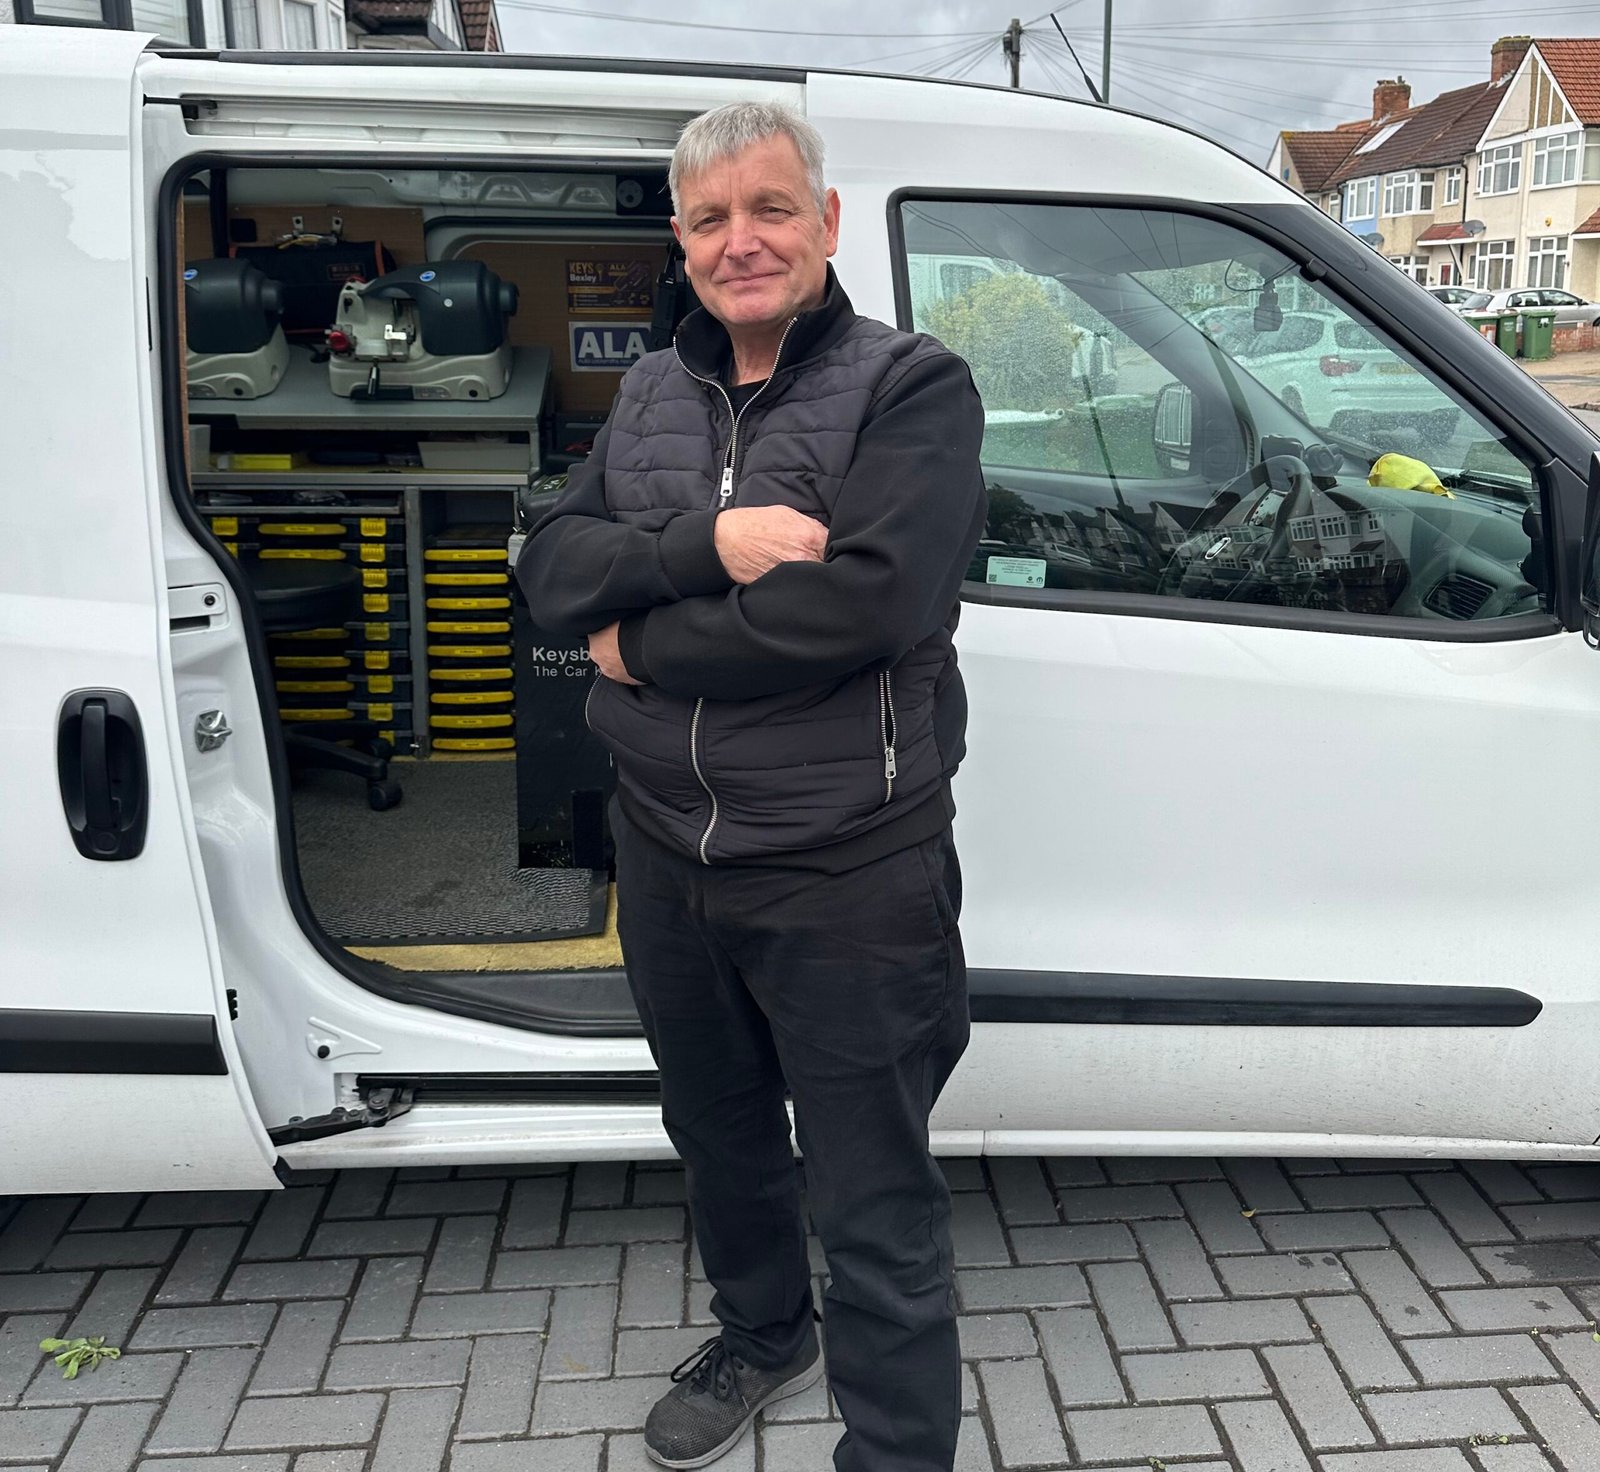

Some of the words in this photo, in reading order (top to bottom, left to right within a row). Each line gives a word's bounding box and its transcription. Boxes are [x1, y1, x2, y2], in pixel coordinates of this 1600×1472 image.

[569, 262, 594, 273] KEYS
[578, 331, 648, 358] ALA
[532, 646, 590, 665] Keysb
[533, 665, 558, 677] The
[564, 665, 588, 677] Car
